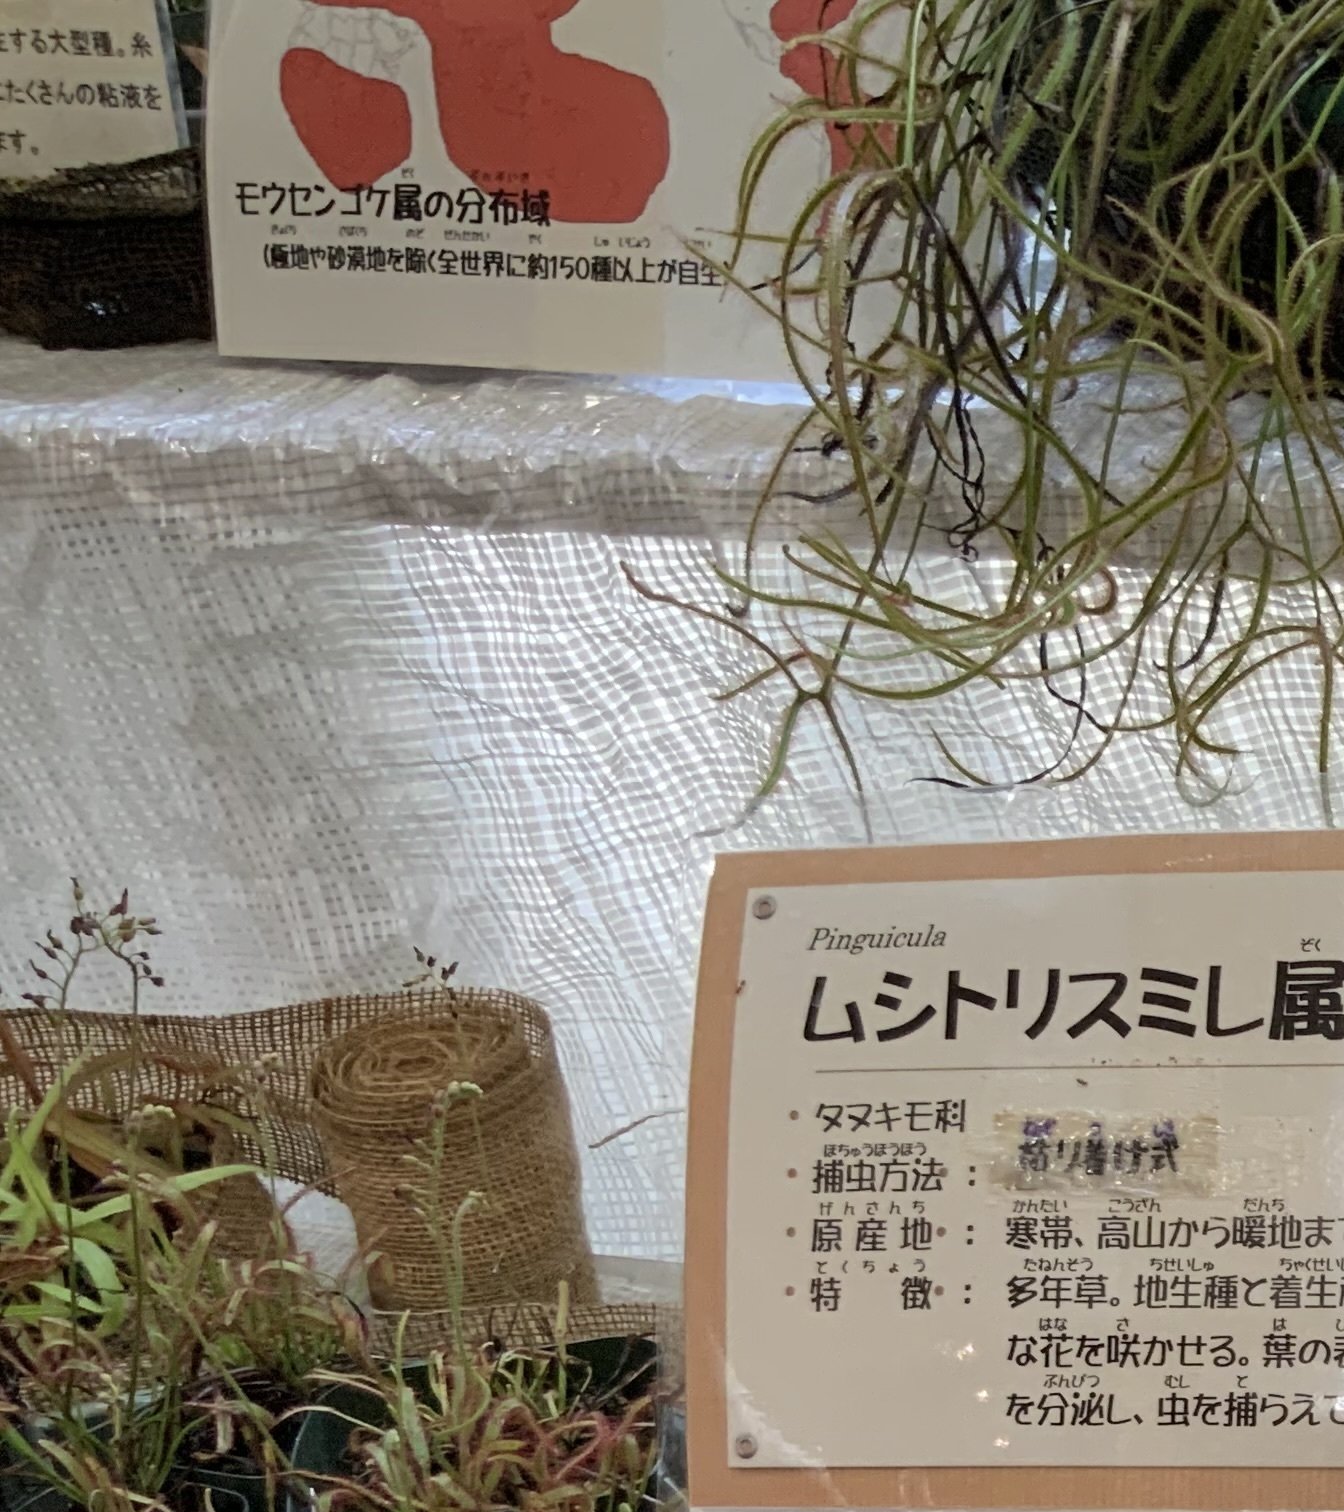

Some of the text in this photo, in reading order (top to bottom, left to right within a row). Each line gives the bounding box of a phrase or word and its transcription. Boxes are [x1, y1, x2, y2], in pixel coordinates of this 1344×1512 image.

[0, 79, 162, 110] たくさんの粘液を
[235, 182, 551, 227] モウセンゴケ属の分布域
[264, 243, 728, 287] (極地や砂漠地を除く全世界に約150種以上が自生
[807, 925, 948, 954] Pinguicula
[815, 1100, 967, 1134] タヌキモ科
[1012, 1199, 1067, 1213] かんたい
[1108, 1199, 1161, 1213] こうざん
[1023, 1257, 1093, 1273] たねんそう
[1149, 1257, 1215, 1273] ちせいしゅ
[1039, 1318, 1067, 1332] はな
[1164, 1374, 1190, 1389] むし
